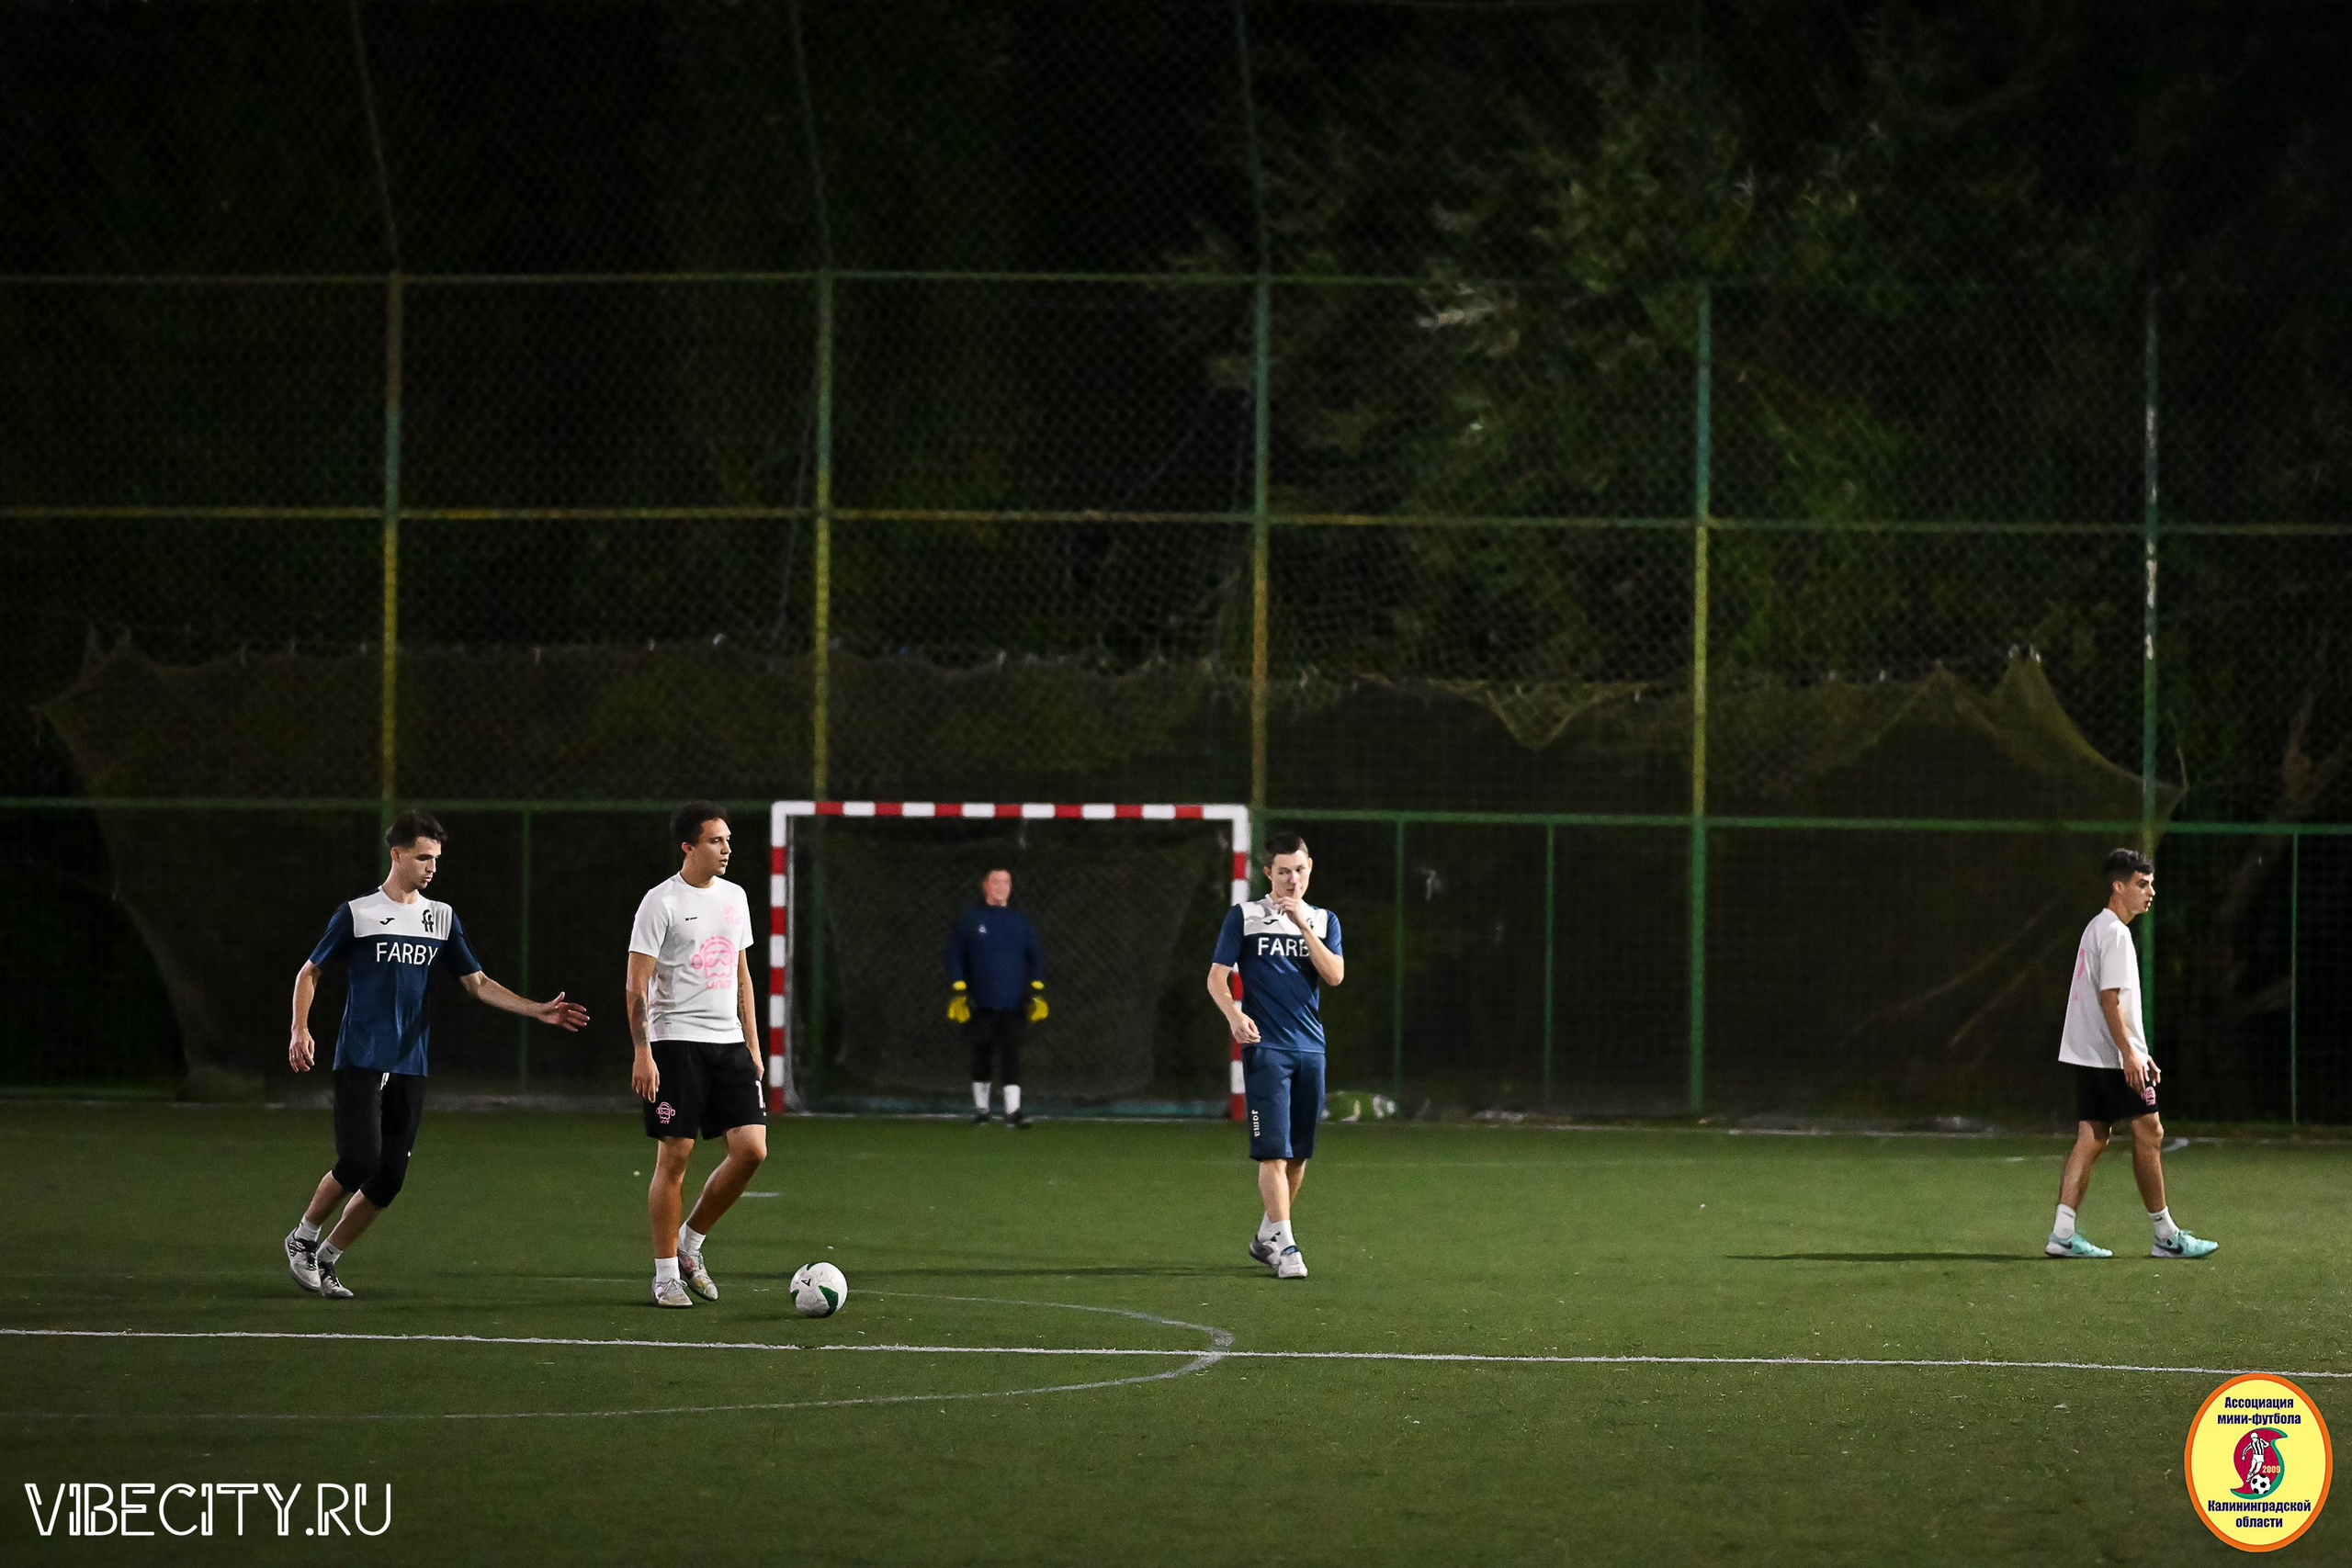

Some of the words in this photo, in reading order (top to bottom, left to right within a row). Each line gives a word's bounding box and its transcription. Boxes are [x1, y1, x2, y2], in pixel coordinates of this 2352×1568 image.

[376, 942, 439, 966] FARBY
[1257, 936, 1310, 957] FARB
[755, 1080, 766, 1109] 1
